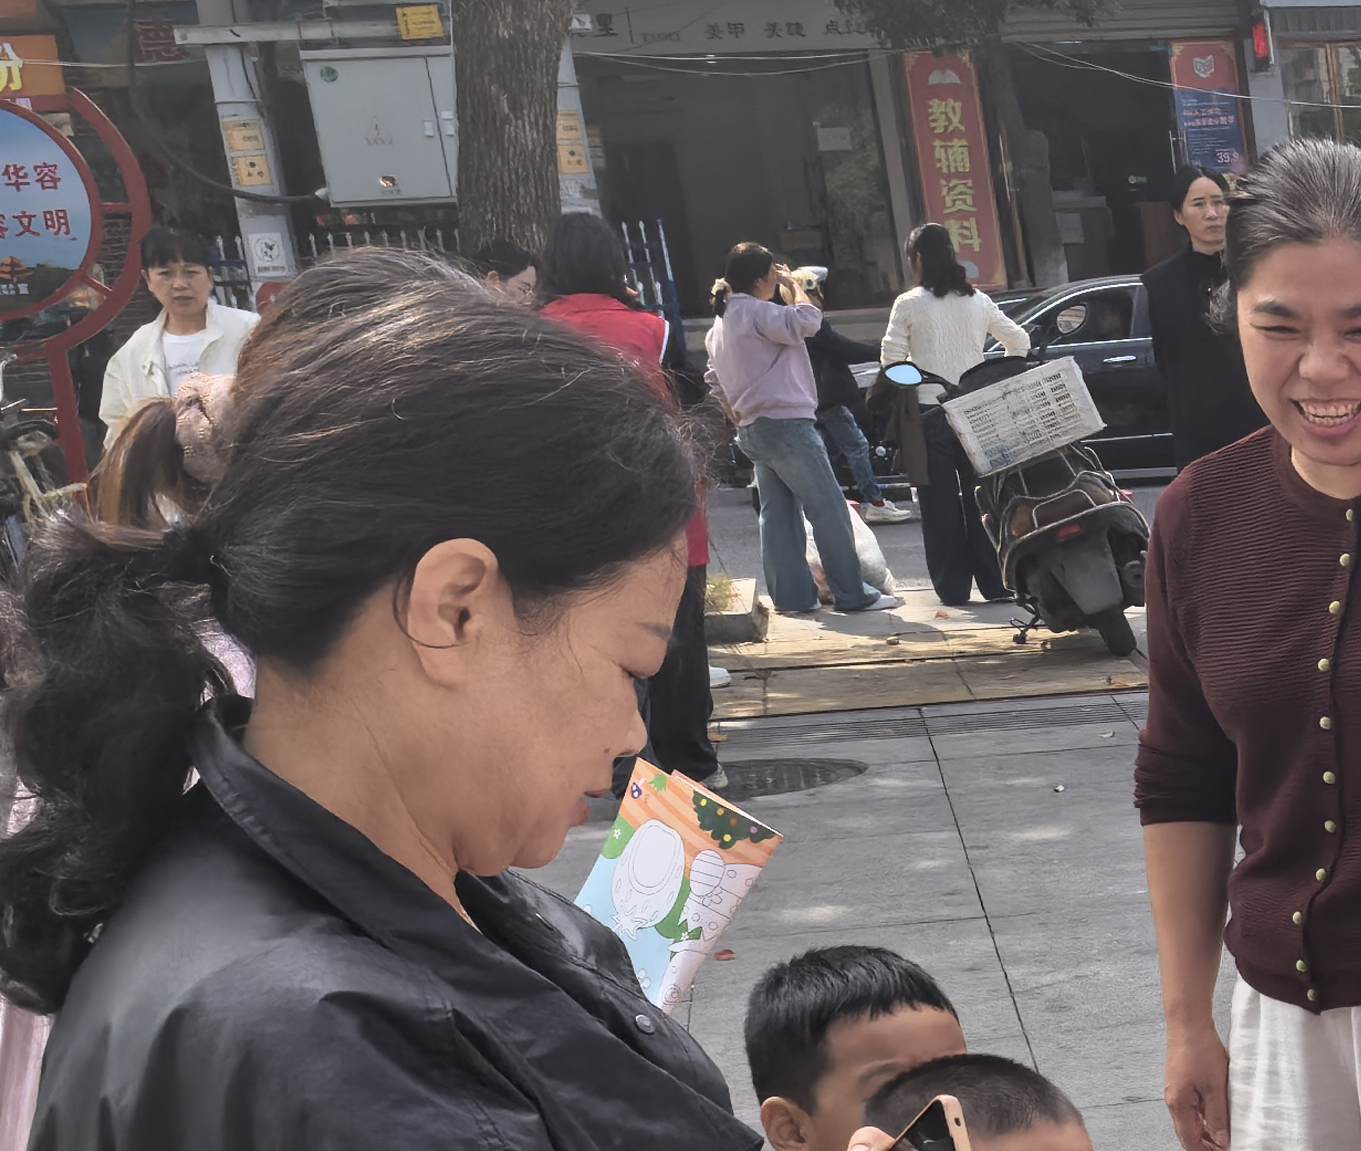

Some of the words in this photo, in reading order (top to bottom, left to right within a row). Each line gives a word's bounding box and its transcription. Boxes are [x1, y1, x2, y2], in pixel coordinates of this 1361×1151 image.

[2, 161, 62, 193] 华容
[927, 97, 982, 254] 教辅资料
